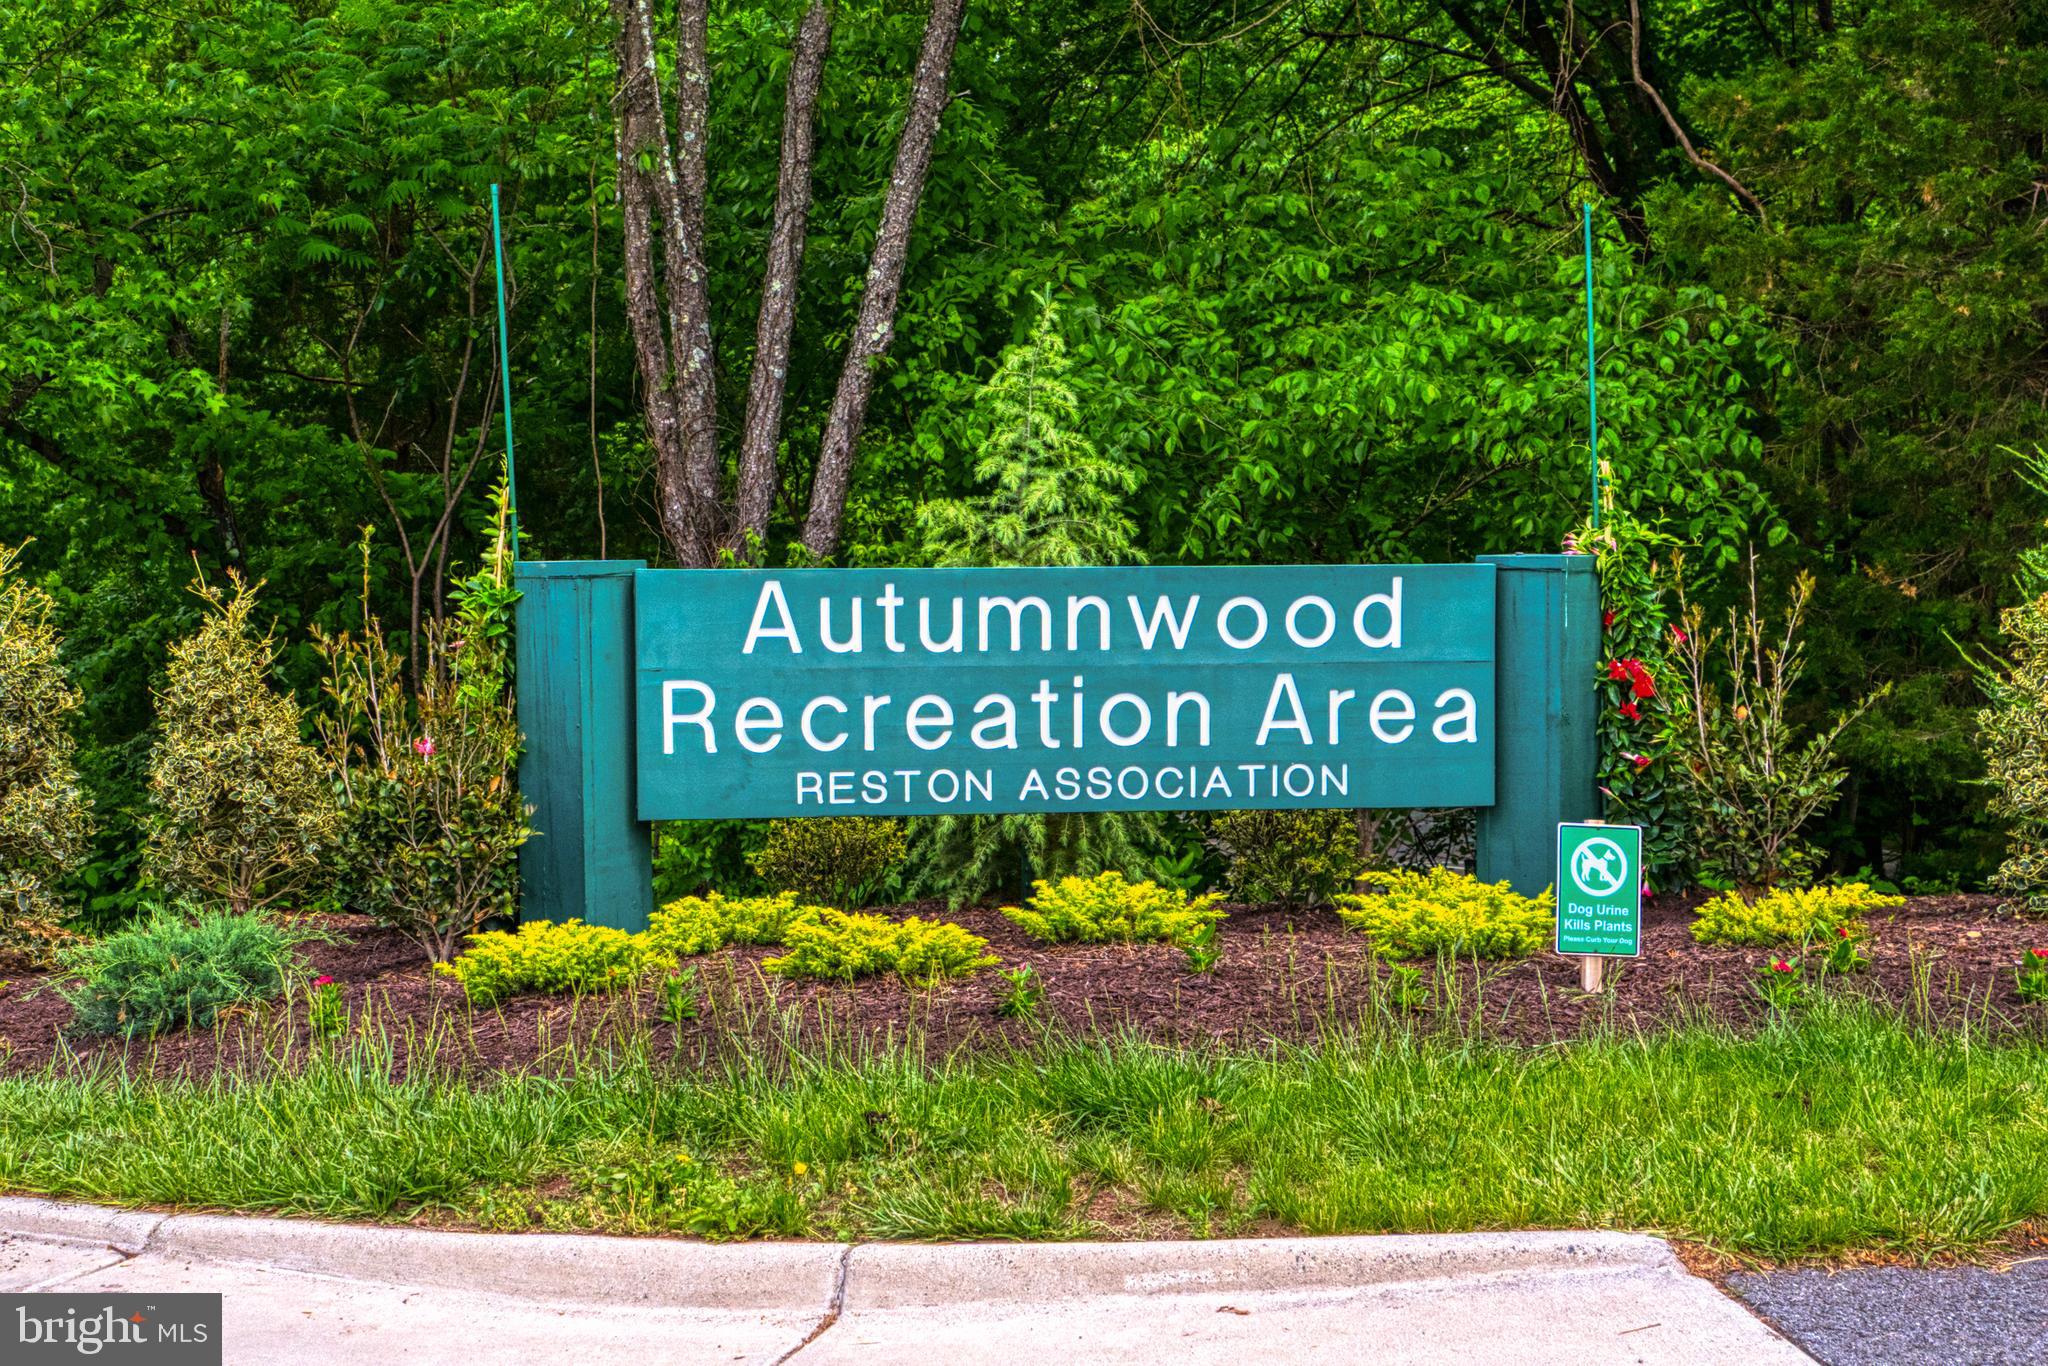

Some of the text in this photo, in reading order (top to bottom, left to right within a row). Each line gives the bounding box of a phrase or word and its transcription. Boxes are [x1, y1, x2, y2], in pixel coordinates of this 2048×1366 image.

[741, 576, 1404, 655] Autumnwood
[661, 673, 1479, 755] Recreation Area
[795, 763, 1350, 806] RESTON ASSOCIATION
[1568, 903, 1629, 917] Dog Urine
[1564, 918, 1632, 932] Kills Plants
[1563, 935, 1633, 946] Please Curb Your Dog
